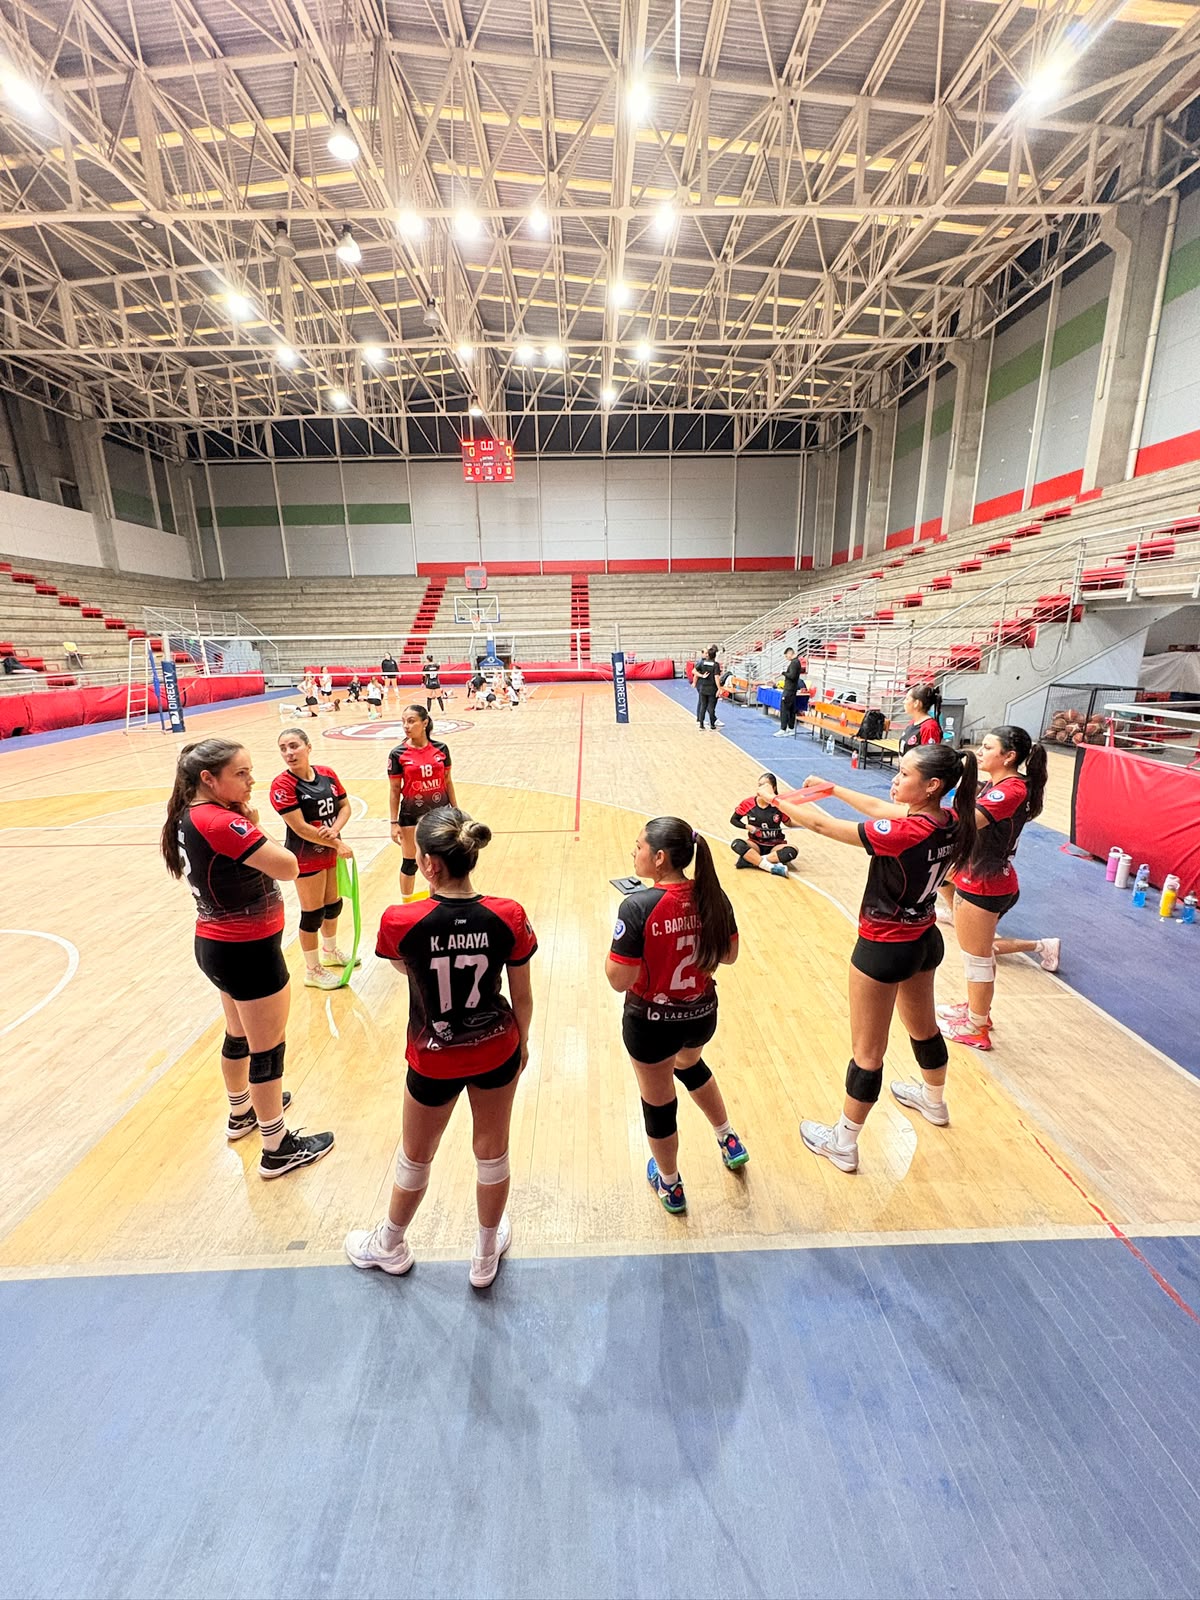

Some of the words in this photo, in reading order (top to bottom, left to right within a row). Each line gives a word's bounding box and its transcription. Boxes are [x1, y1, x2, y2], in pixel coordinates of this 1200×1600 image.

[164, 671, 178, 710] DIRECTV
[616, 677, 627, 715] DIRECTV
[419, 764, 433, 778] 18
[421, 778, 441, 790] AMU
[317, 797, 334, 817] 26
[651, 921, 662, 936] C.
[430, 936, 444, 952] K.
[447, 932, 489, 950] ARAYA
[669, 934, 700, 990] 2
[429, 954, 489, 1014] 17
